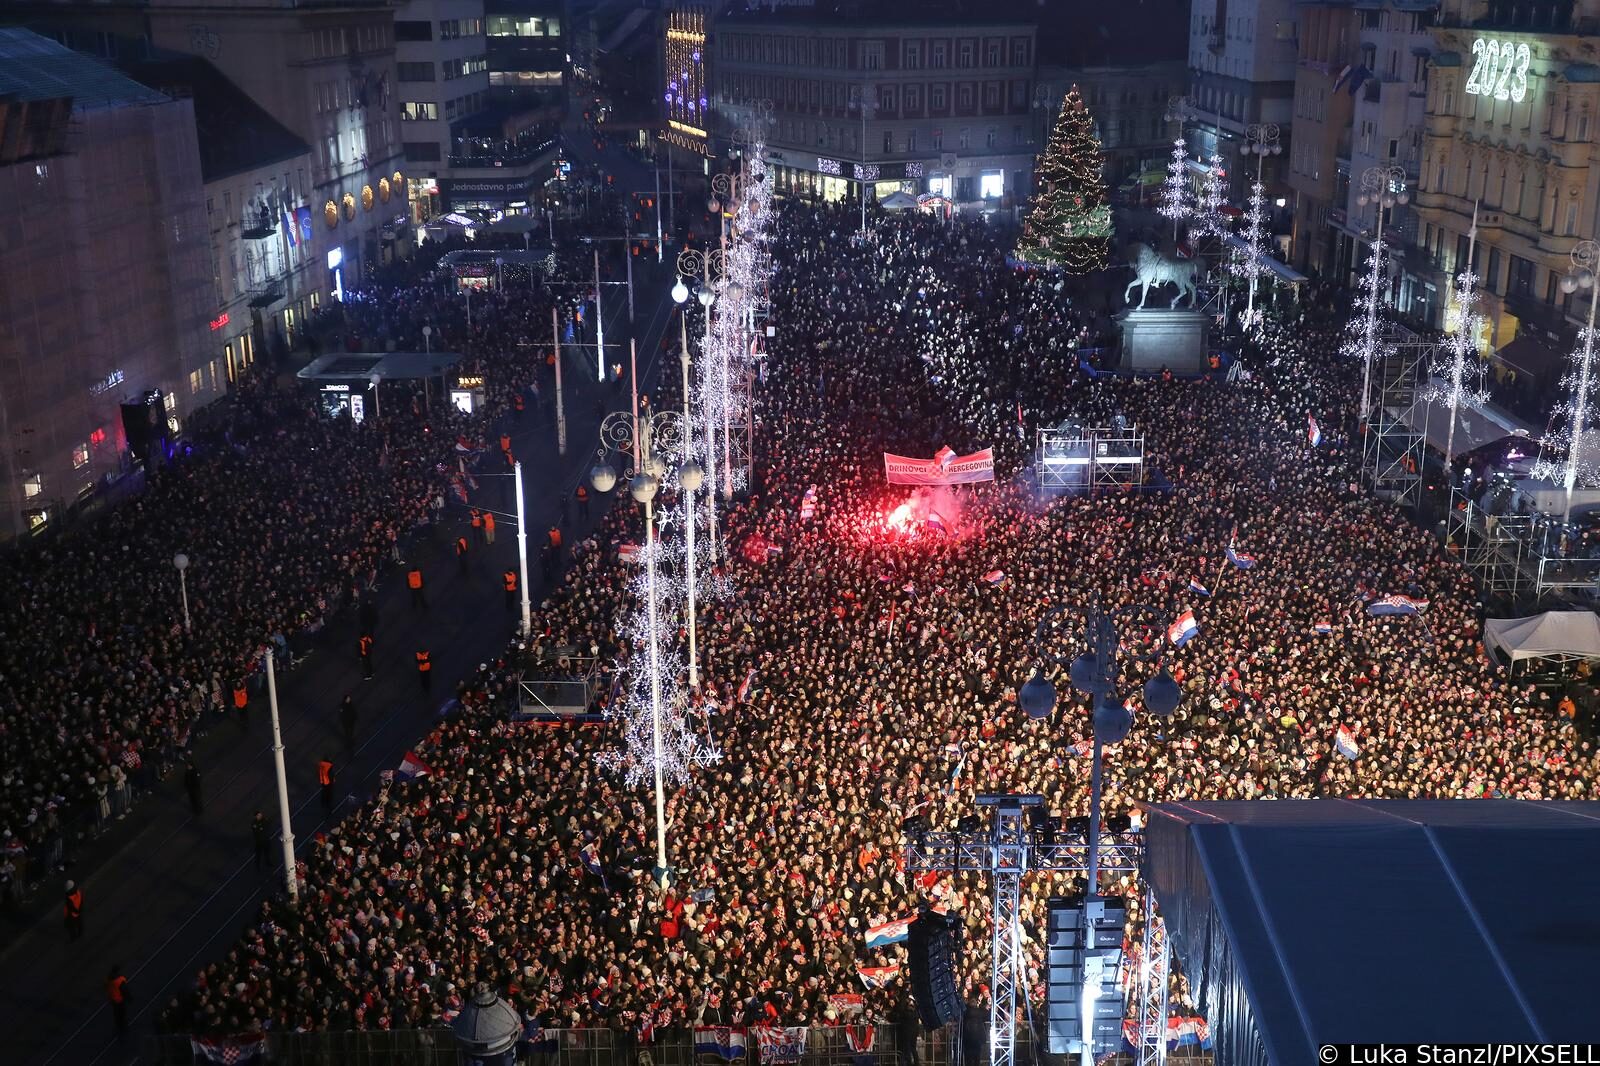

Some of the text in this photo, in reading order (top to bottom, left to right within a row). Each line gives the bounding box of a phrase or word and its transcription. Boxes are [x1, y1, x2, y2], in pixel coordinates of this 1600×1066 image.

[1465, 38, 1530, 103] 2023
[450, 182, 504, 191] Jednostavno
[888, 460, 993, 473] DRINOVCI HERCEGOVINA
